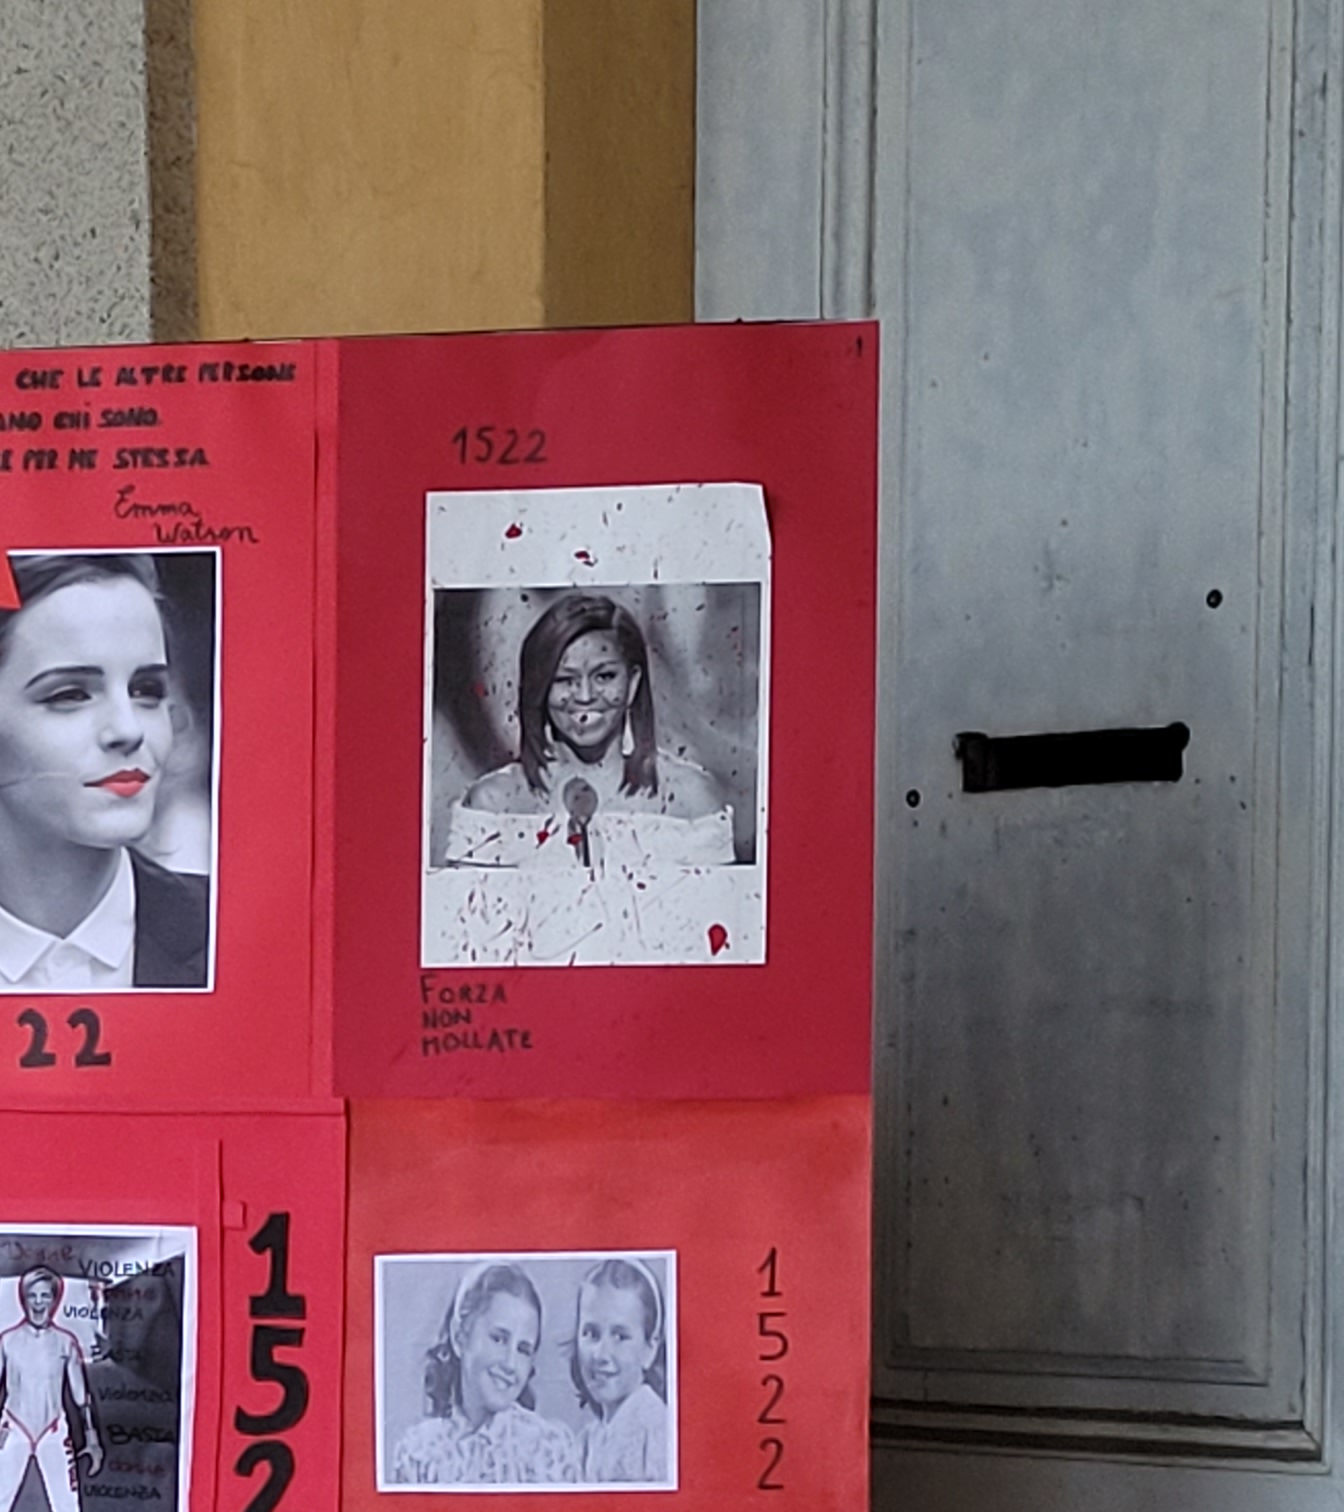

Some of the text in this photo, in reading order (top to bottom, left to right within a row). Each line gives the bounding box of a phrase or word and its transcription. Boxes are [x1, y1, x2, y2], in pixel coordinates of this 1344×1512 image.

[452, 427, 548, 465] 1522
[114, 484, 197, 520] Emma
[156, 523, 261, 543] Watson
[422, 1007, 472, 1030] NON
[78, 1259, 176, 1278] VIOLENZA
[63, 1304, 145, 1322] VIOLENZA
[756, 1246, 790, 1492] 1522
[106, 1423, 175, 1446] BASTA
